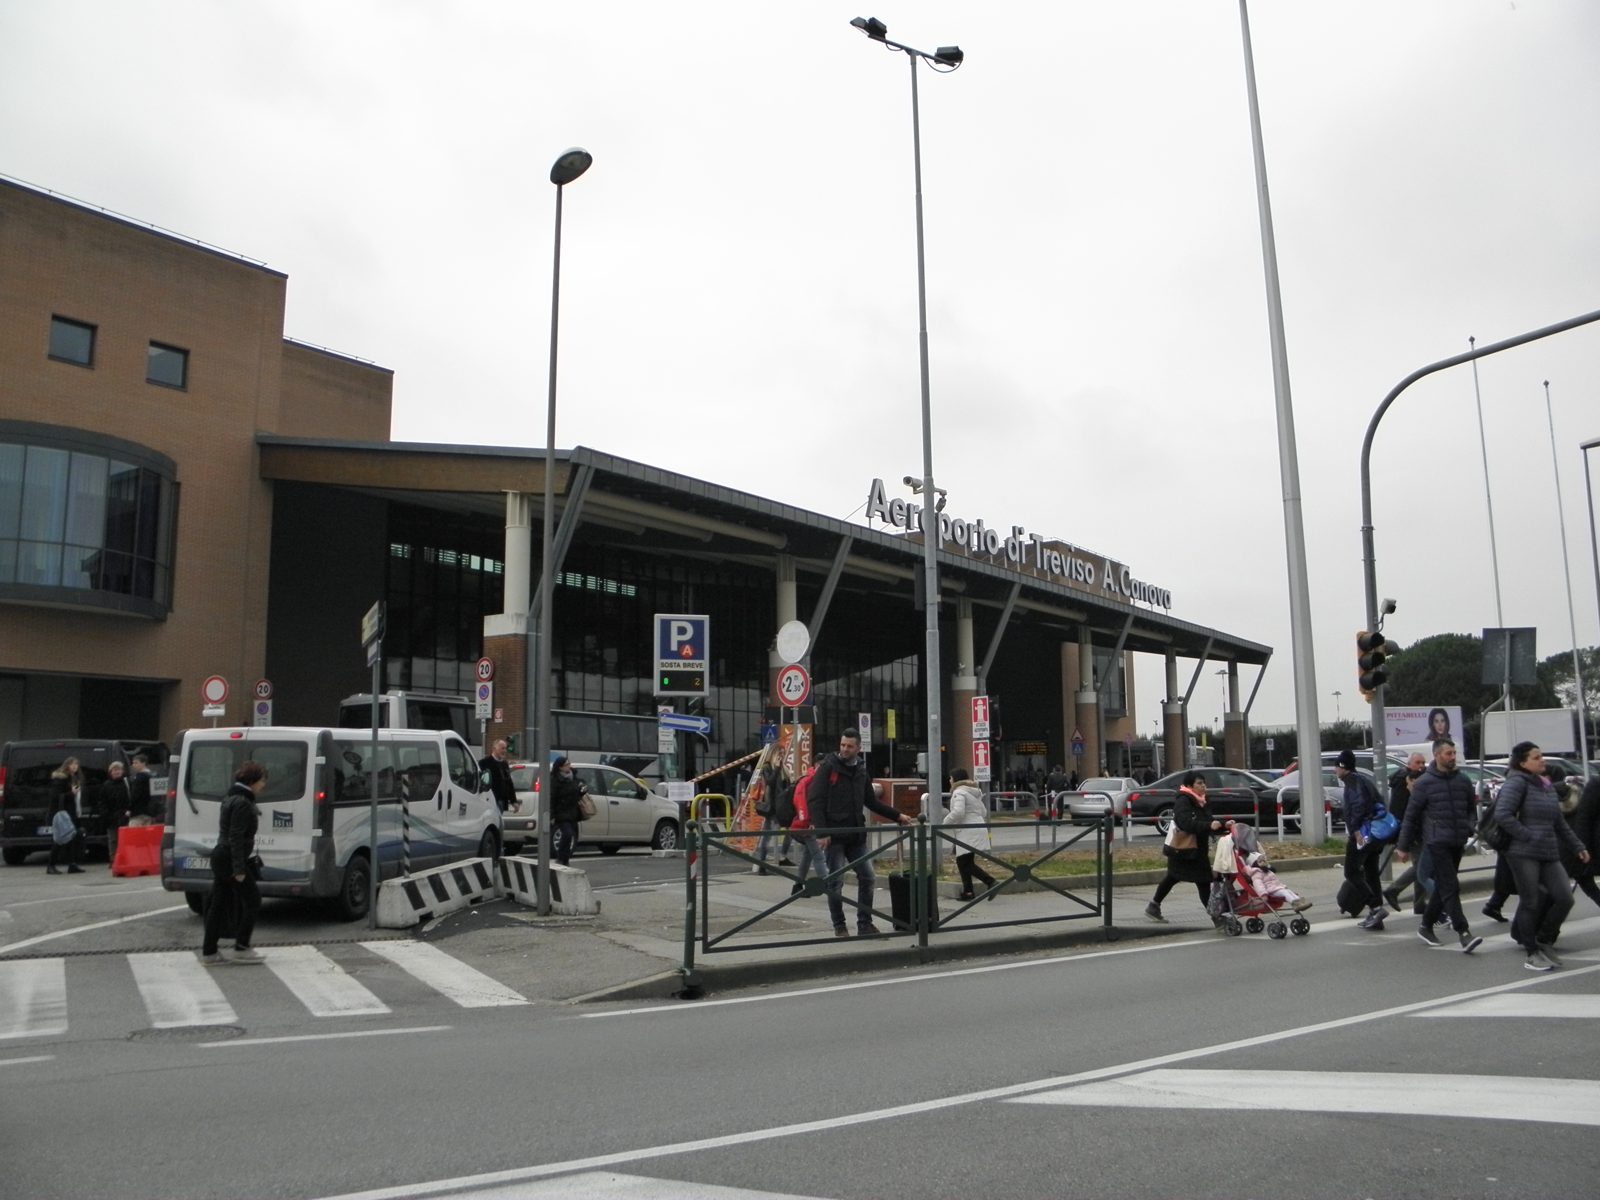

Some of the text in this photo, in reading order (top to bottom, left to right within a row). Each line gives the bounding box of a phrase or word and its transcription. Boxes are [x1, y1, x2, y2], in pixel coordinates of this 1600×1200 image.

[1005, 525, 1026, 564] di
[1029, 533, 1095, 585] Treviso
[670, 620, 694, 651] P
[682, 644, 693, 656] A
[480, 663, 490, 675] 20
[660, 661, 682, 669] SOSTA
[258, 684, 269, 694] 20
[785, 676, 793, 693] 2
